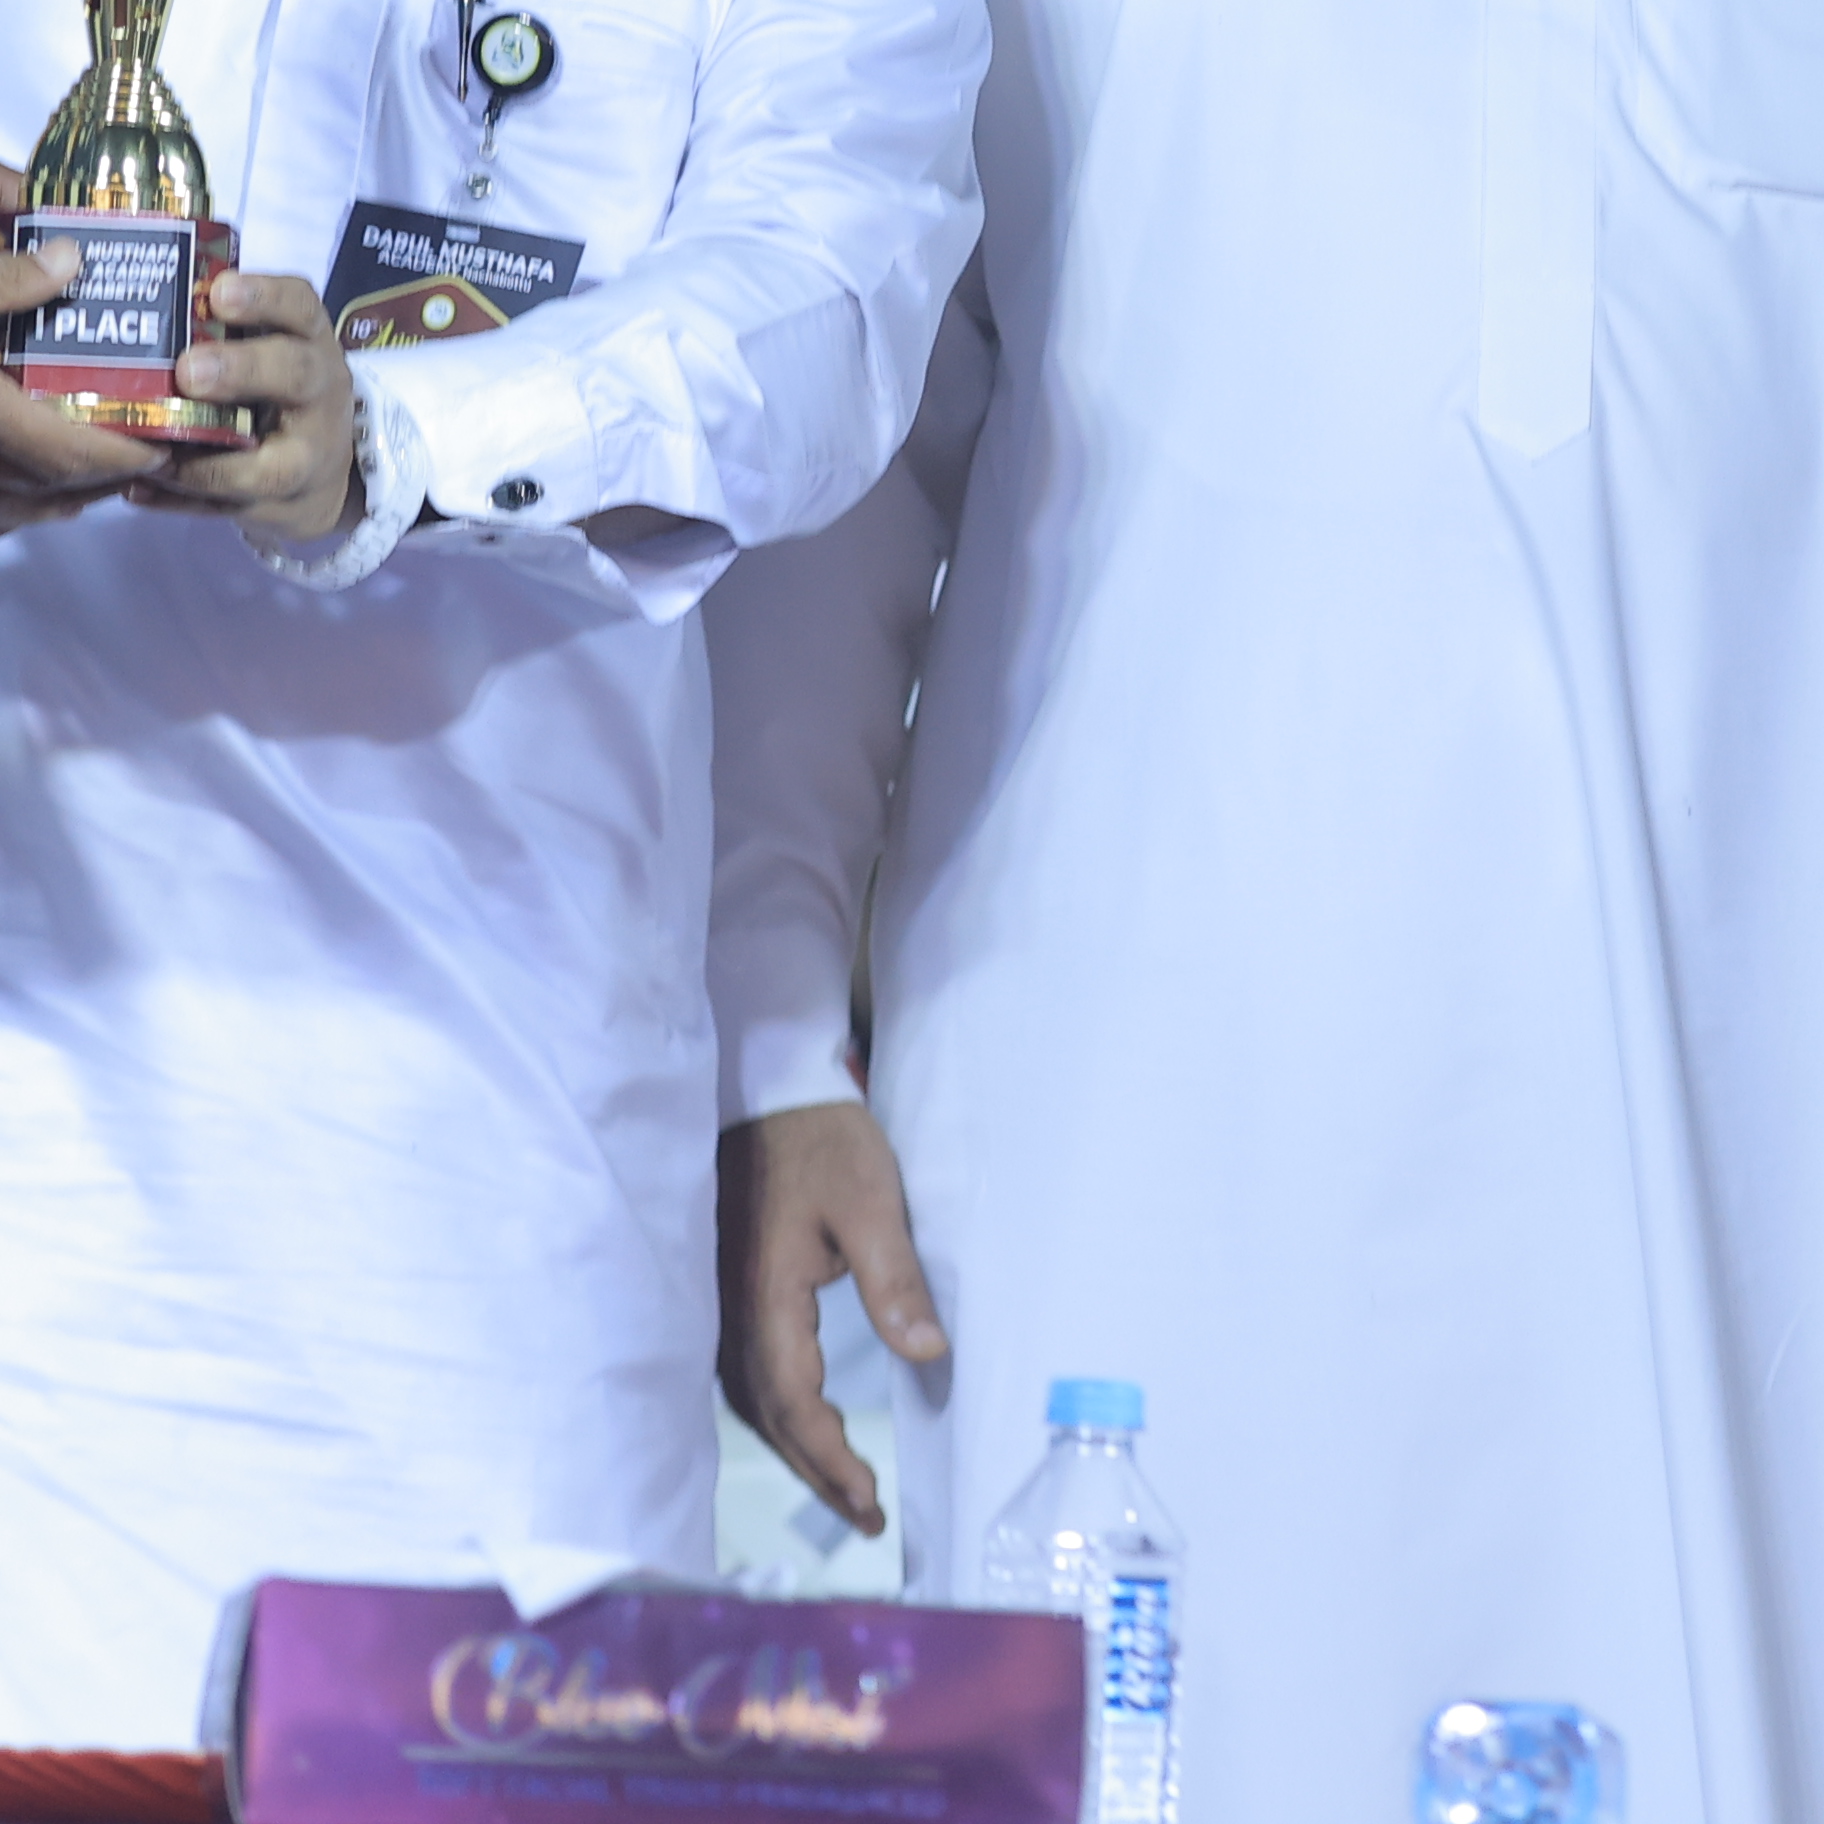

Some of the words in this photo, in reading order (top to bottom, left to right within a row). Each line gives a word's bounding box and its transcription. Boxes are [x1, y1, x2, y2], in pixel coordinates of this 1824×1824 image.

[85, 239, 180, 264] MUSTHAFA
[91, 260, 177, 285] ACADEMY
[53, 306, 160, 346] PLACE
